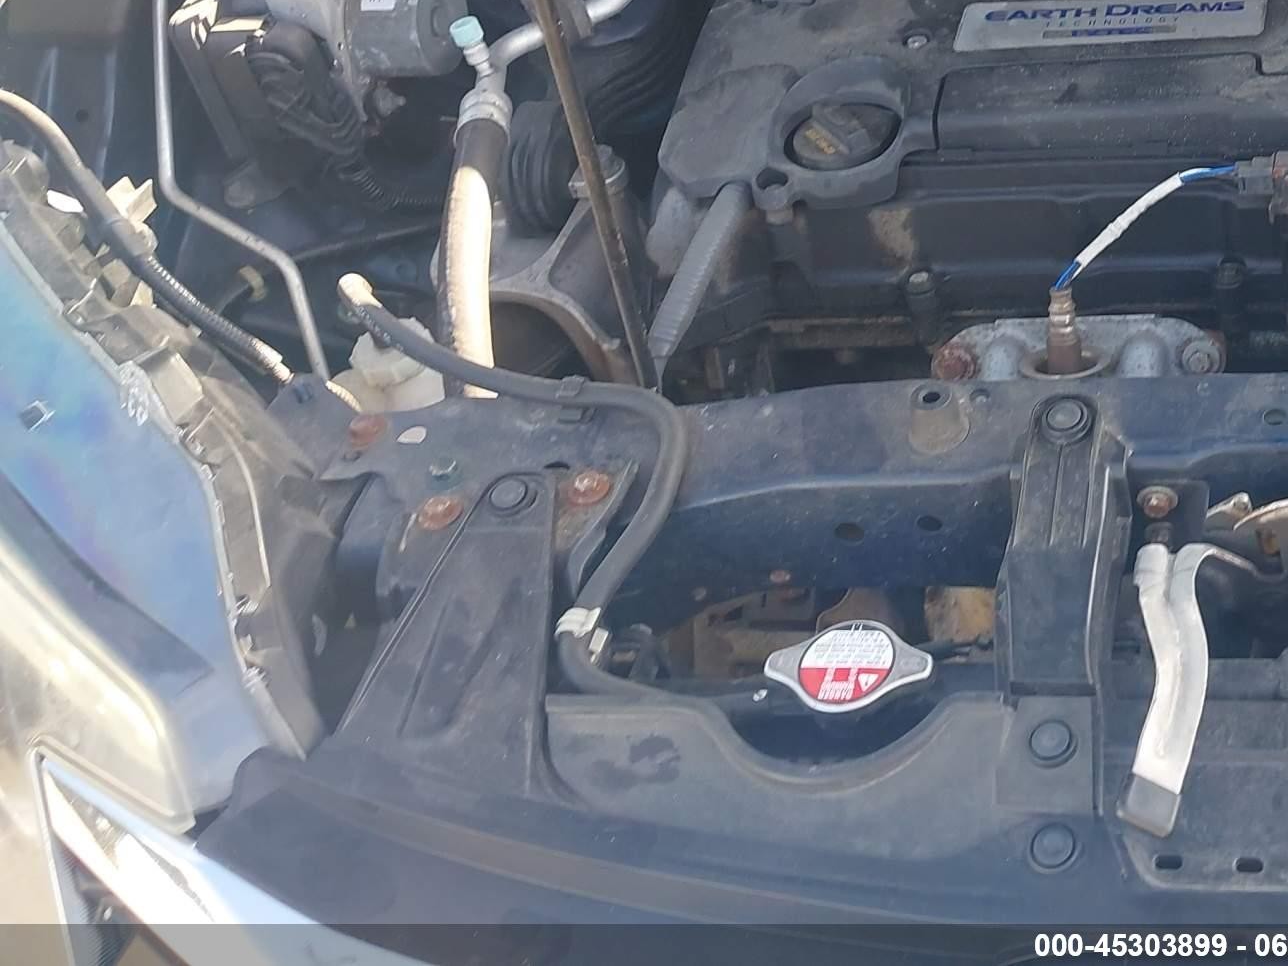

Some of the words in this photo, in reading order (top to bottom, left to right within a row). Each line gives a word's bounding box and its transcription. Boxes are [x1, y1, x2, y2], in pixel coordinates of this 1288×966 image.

[985, 7, 1098, 22] EARTH
[1105, 0, 1246, 16] DREAMS
[1045, 16, 1180, 28] TECHNOLOGY
